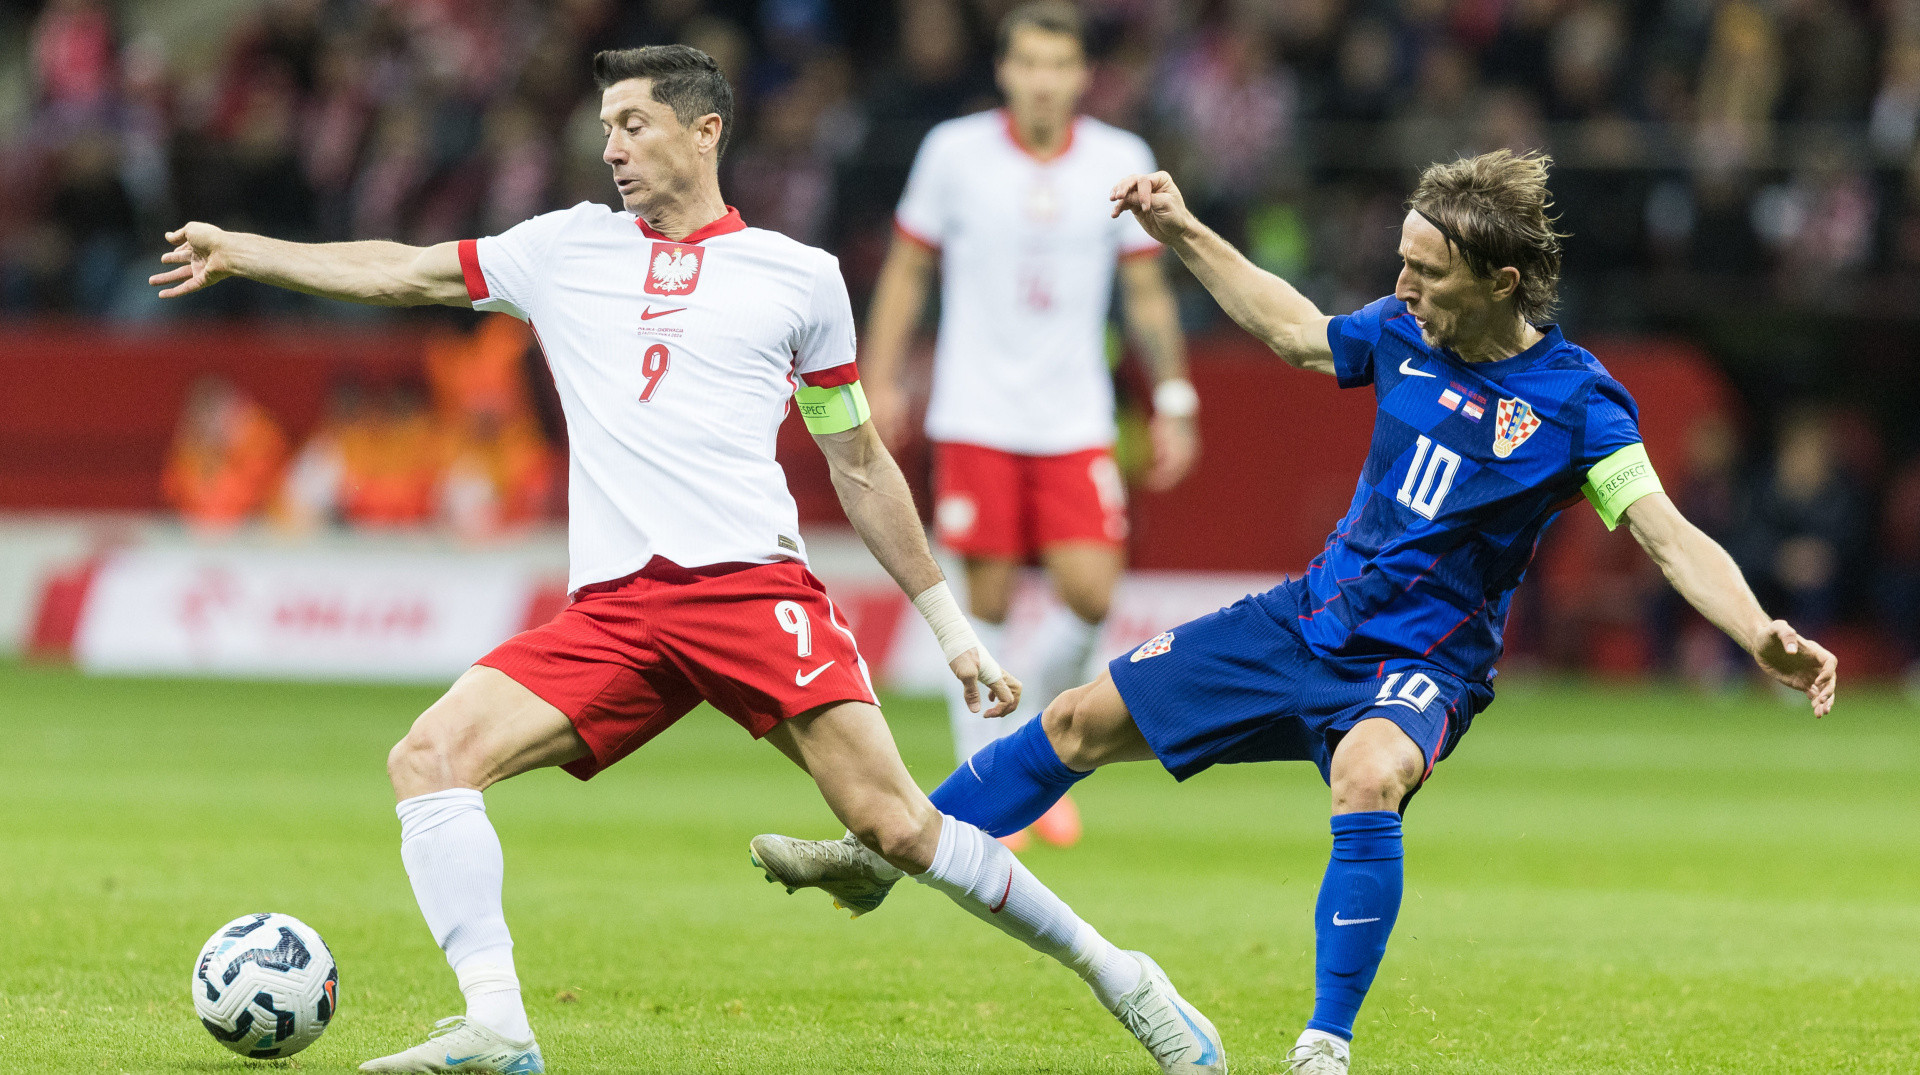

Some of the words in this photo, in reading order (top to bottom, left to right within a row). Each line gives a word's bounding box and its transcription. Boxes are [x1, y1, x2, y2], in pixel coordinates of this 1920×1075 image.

[639, 343, 671, 403] 9
[1396, 433, 1462, 521] 10
[1605, 464, 1646, 494] RESPECT
[774, 600, 812, 657] 9
[1374, 672, 1440, 713] 10
